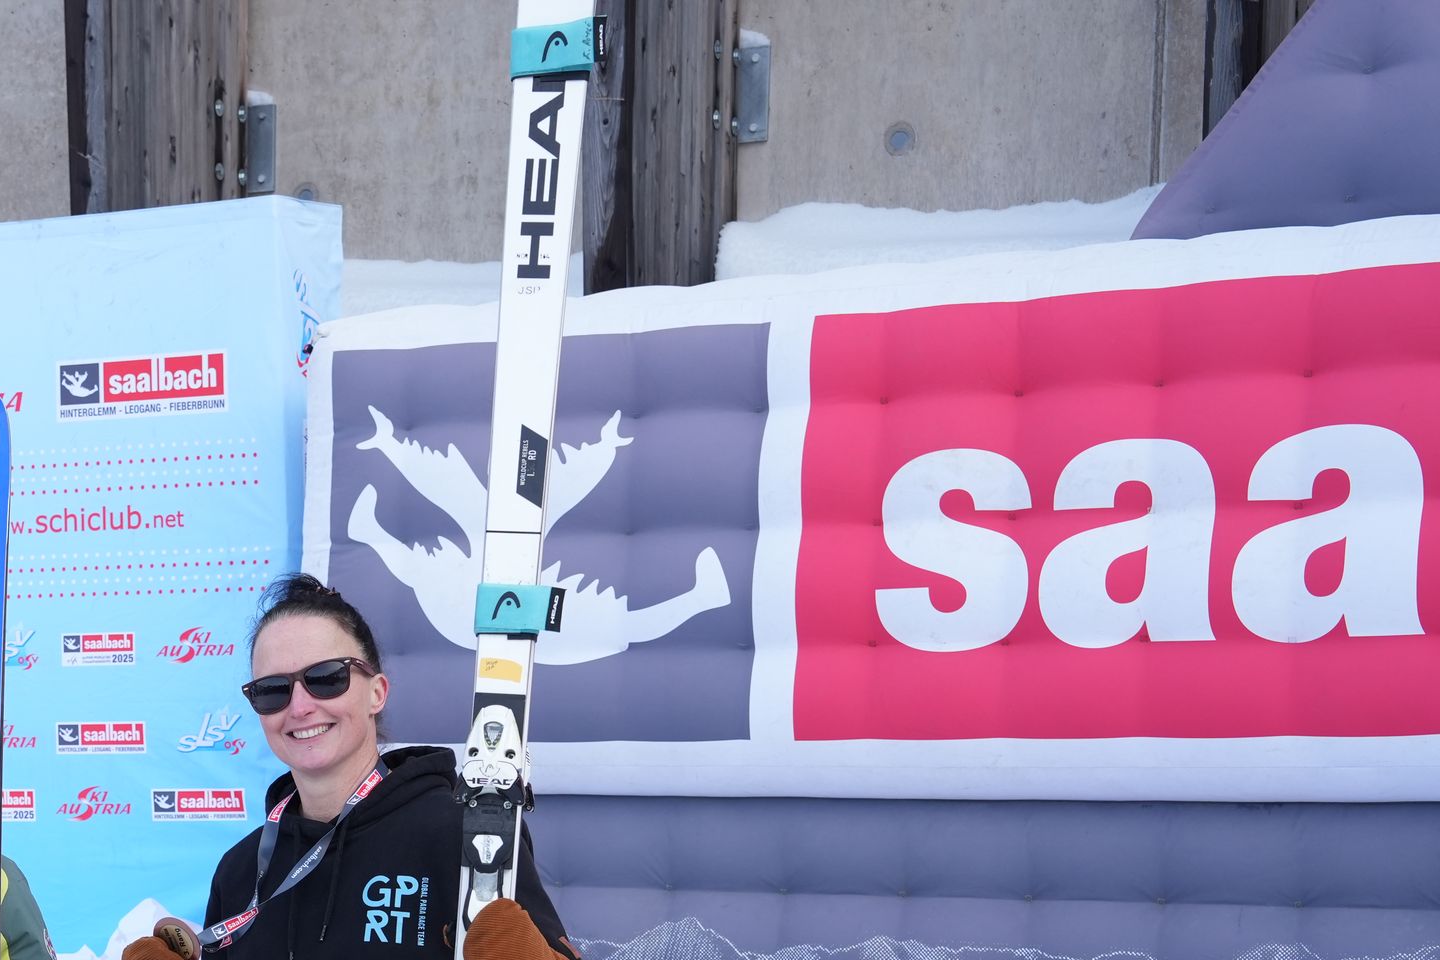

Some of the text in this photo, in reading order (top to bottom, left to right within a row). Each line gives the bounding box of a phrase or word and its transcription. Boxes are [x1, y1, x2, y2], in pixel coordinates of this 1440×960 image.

[109, 353, 218, 396] saalbach
[60, 405, 117, 419] HINTERGLEMM
[124, 402, 161, 415] LEOGANG
[169, 399, 226, 412] FIEBERBRUNN
[549, 595, 560, 624] HEAD
[84, 633, 131, 650] saalbach
[112, 654, 134, 664] 2025
[157, 644, 235, 663] AUSTRIA
[83, 723, 141, 743] saalbach
[180, 791, 240, 809] saalbach
[13, 810, 34, 820] 2025
[56, 802, 132, 821] AUSTRIA
[417, 877, 429, 947] GLOBAL PARA RACE TEAM
